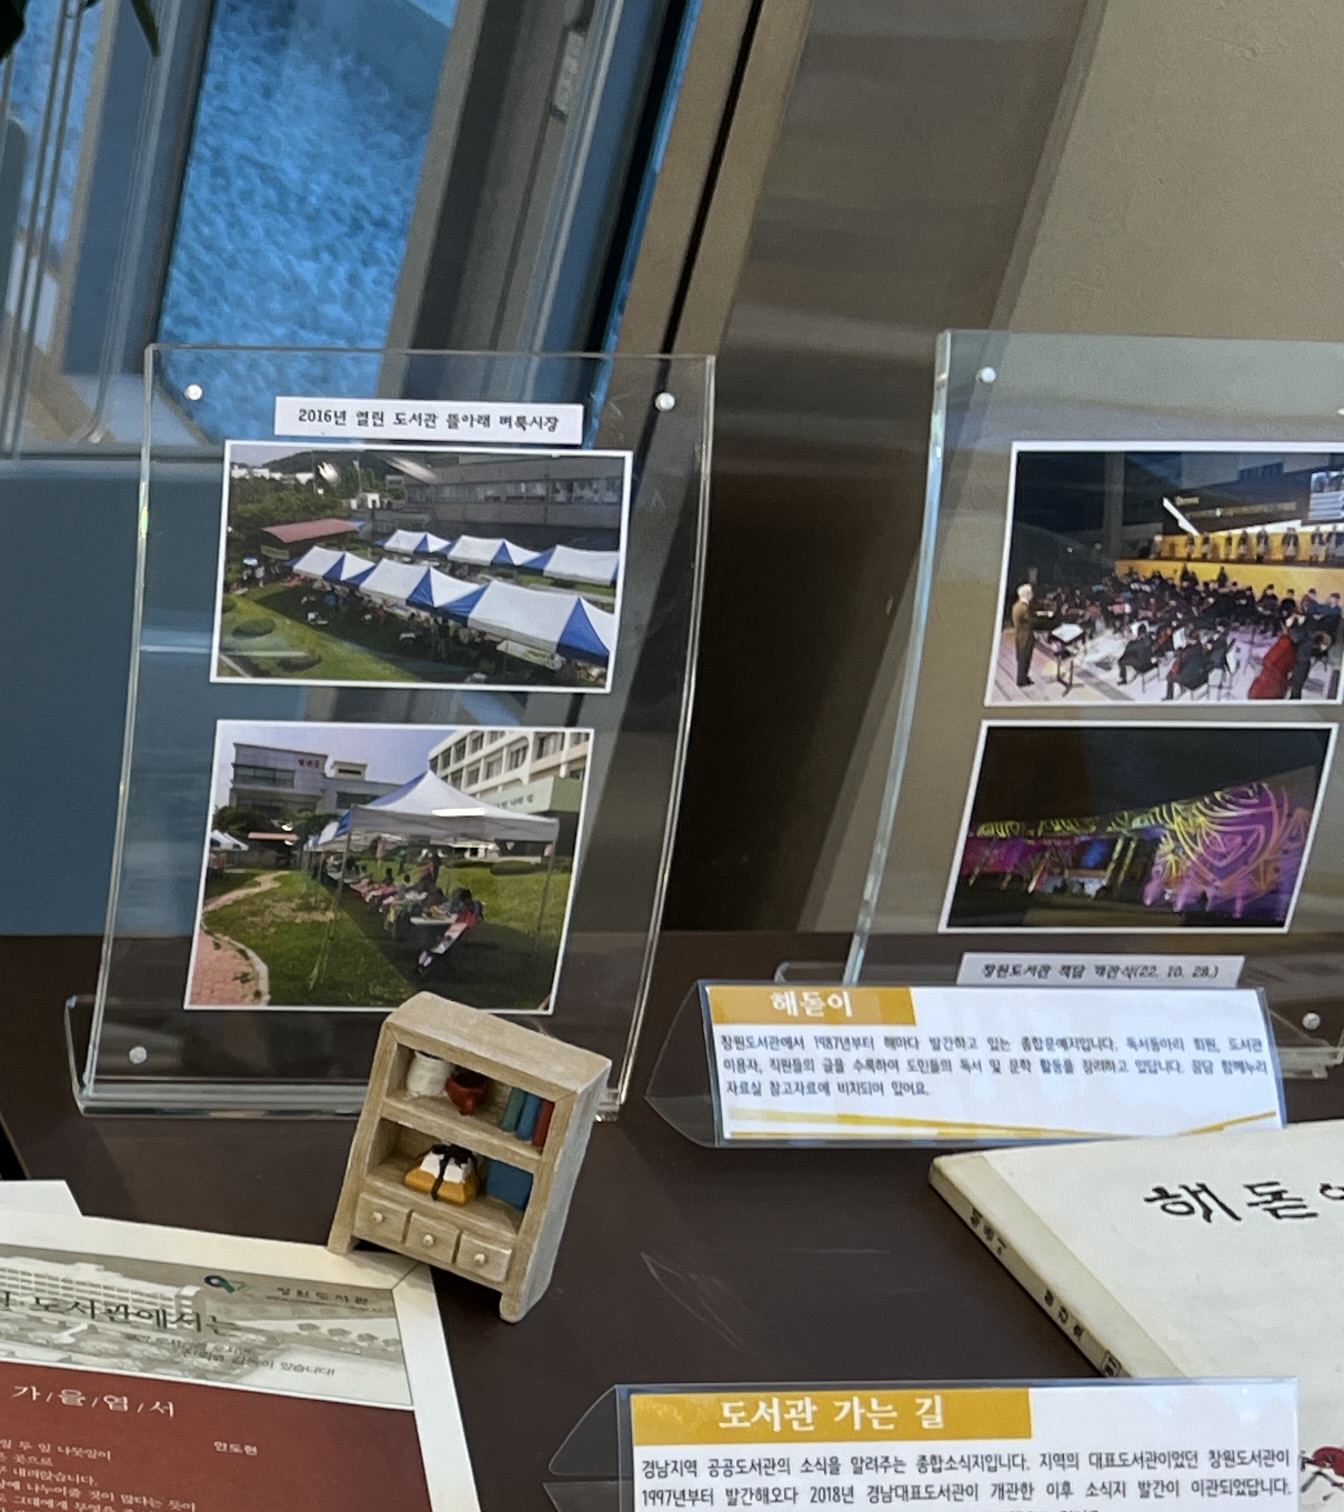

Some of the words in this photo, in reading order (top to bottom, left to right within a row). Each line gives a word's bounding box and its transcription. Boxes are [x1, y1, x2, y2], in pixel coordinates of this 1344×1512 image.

[299, 408, 346, 426] 2016년
[356, 411, 384, 427] 열린
[393, 412, 438, 429] 도서관
[447, 414, 490, 429] 뜰아래
[500, 415, 558, 432] 벼룩시장
[770, 990, 852, 1017] 해돋이
[719, 1396, 818, 1432] 도서관
[833, 1396, 897, 1430] 가는
[916, 1394, 943, 1429] 길
